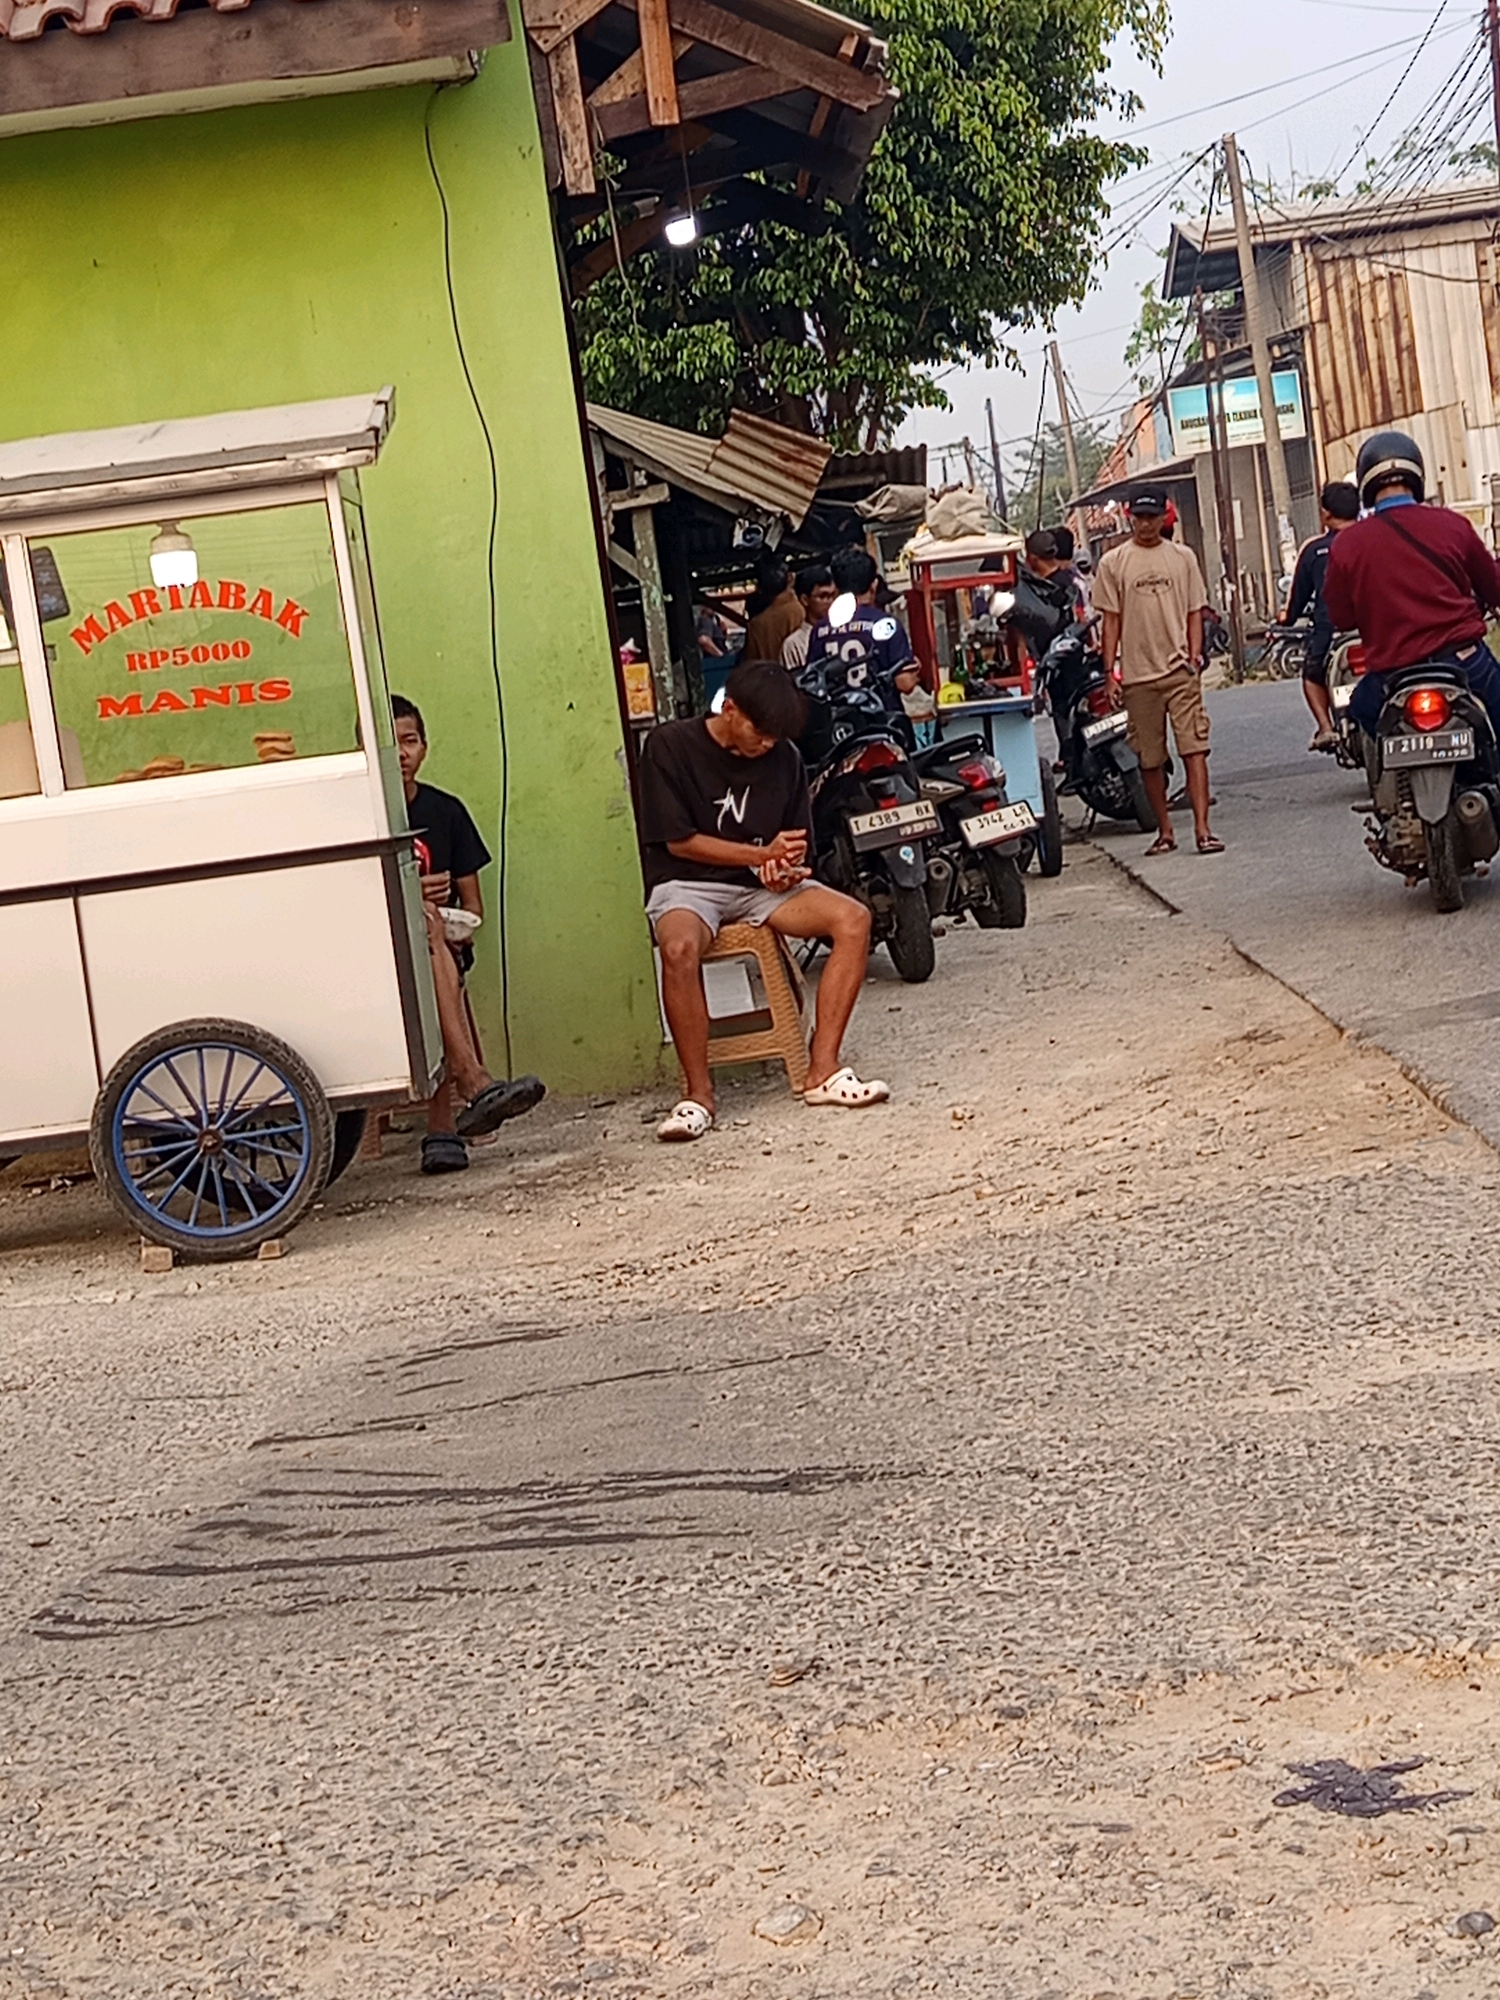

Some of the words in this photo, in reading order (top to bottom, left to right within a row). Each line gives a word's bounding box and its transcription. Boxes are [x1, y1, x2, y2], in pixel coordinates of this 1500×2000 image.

[69, 579, 309, 655] MARTABAK
[125, 639, 252, 673] RP5000
[96, 679, 292, 719] MANIS
